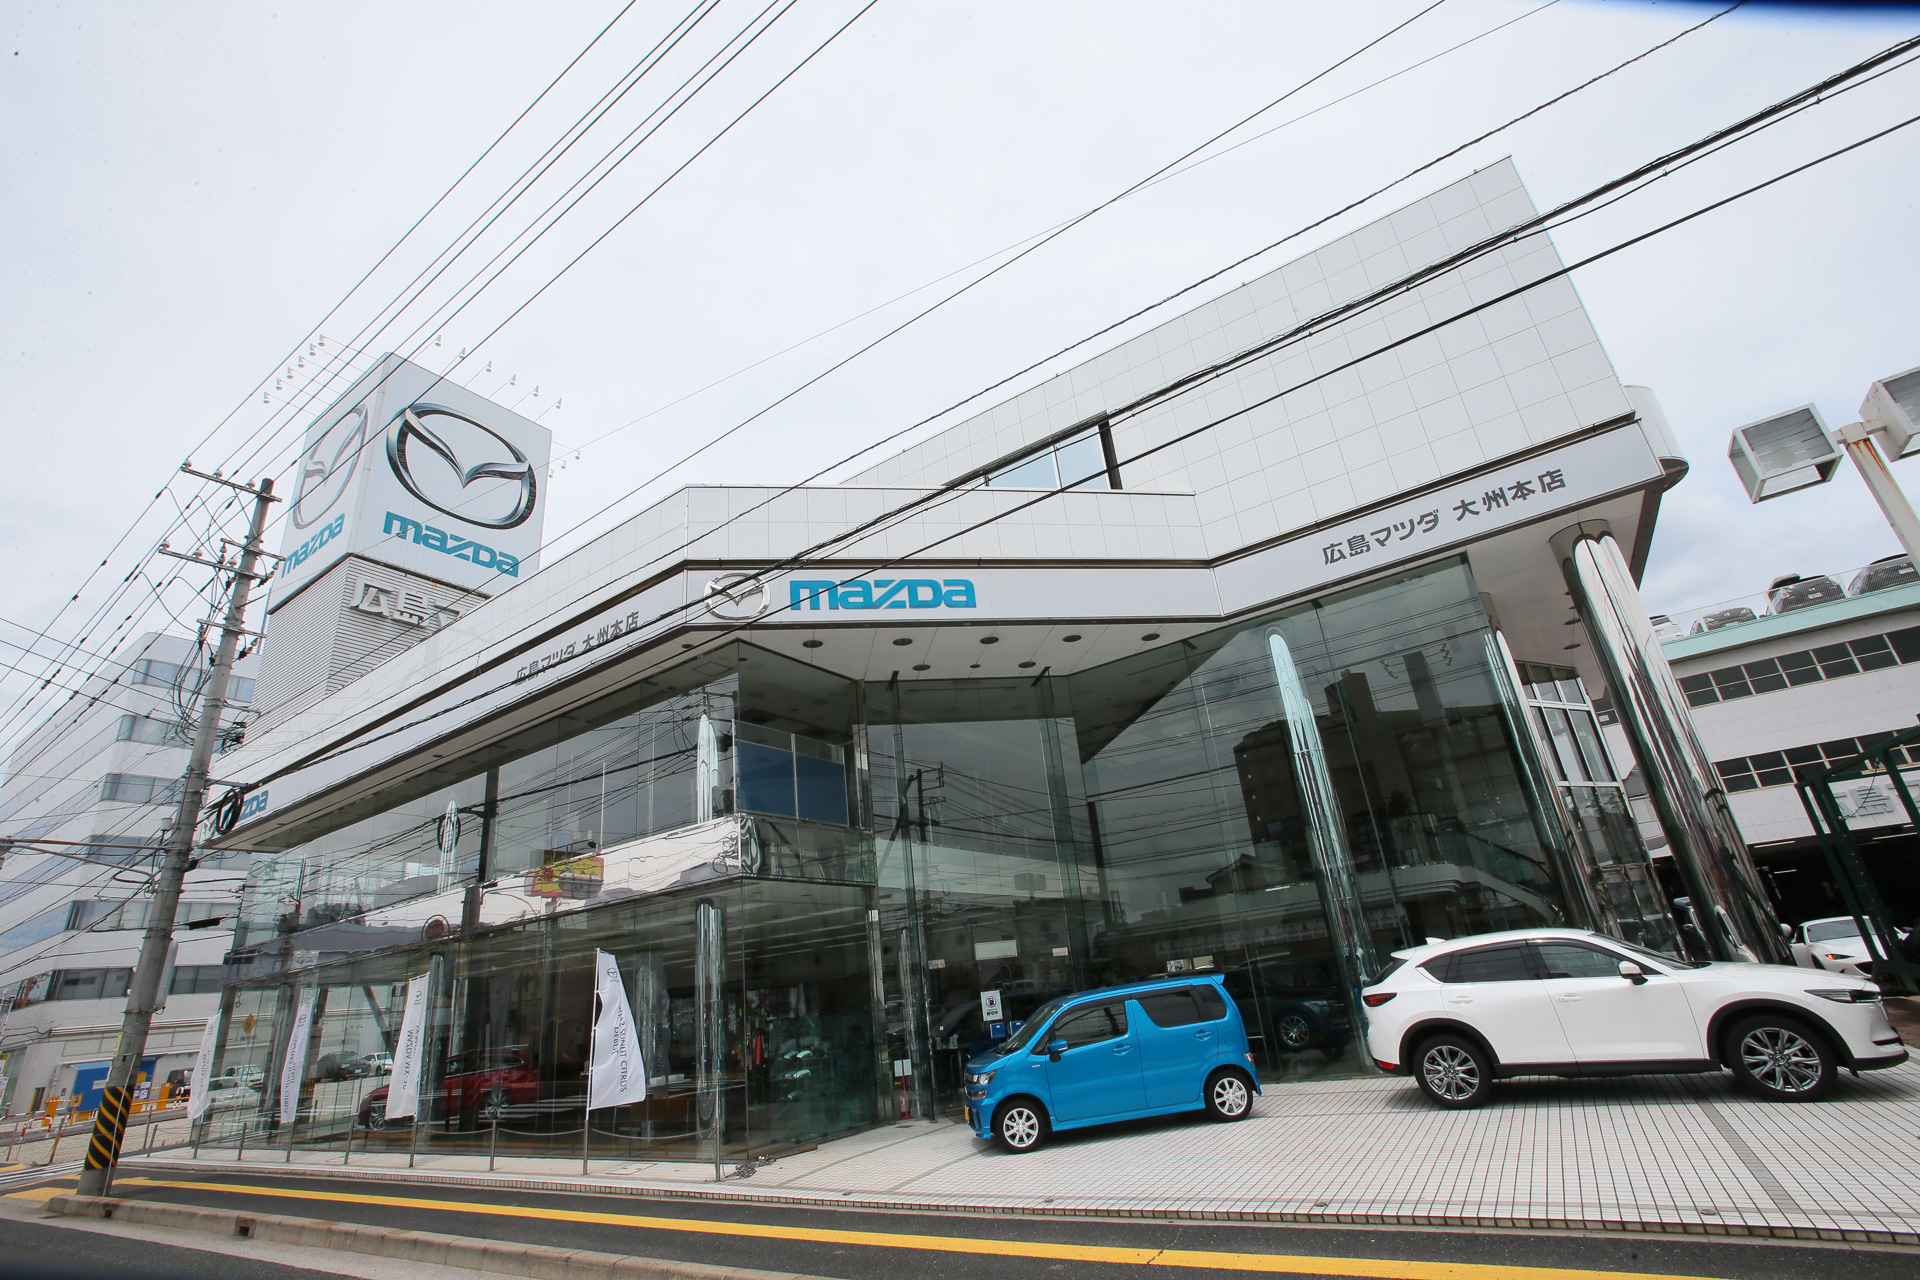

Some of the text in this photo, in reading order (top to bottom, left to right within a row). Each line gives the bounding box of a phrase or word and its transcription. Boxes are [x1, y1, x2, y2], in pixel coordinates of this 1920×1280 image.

[1322, 468, 1567, 566] 広島マツダ 大州本店
[619, 1028, 627, 1058] SUNLIT
[619, 1060, 628, 1093] CITRUS
